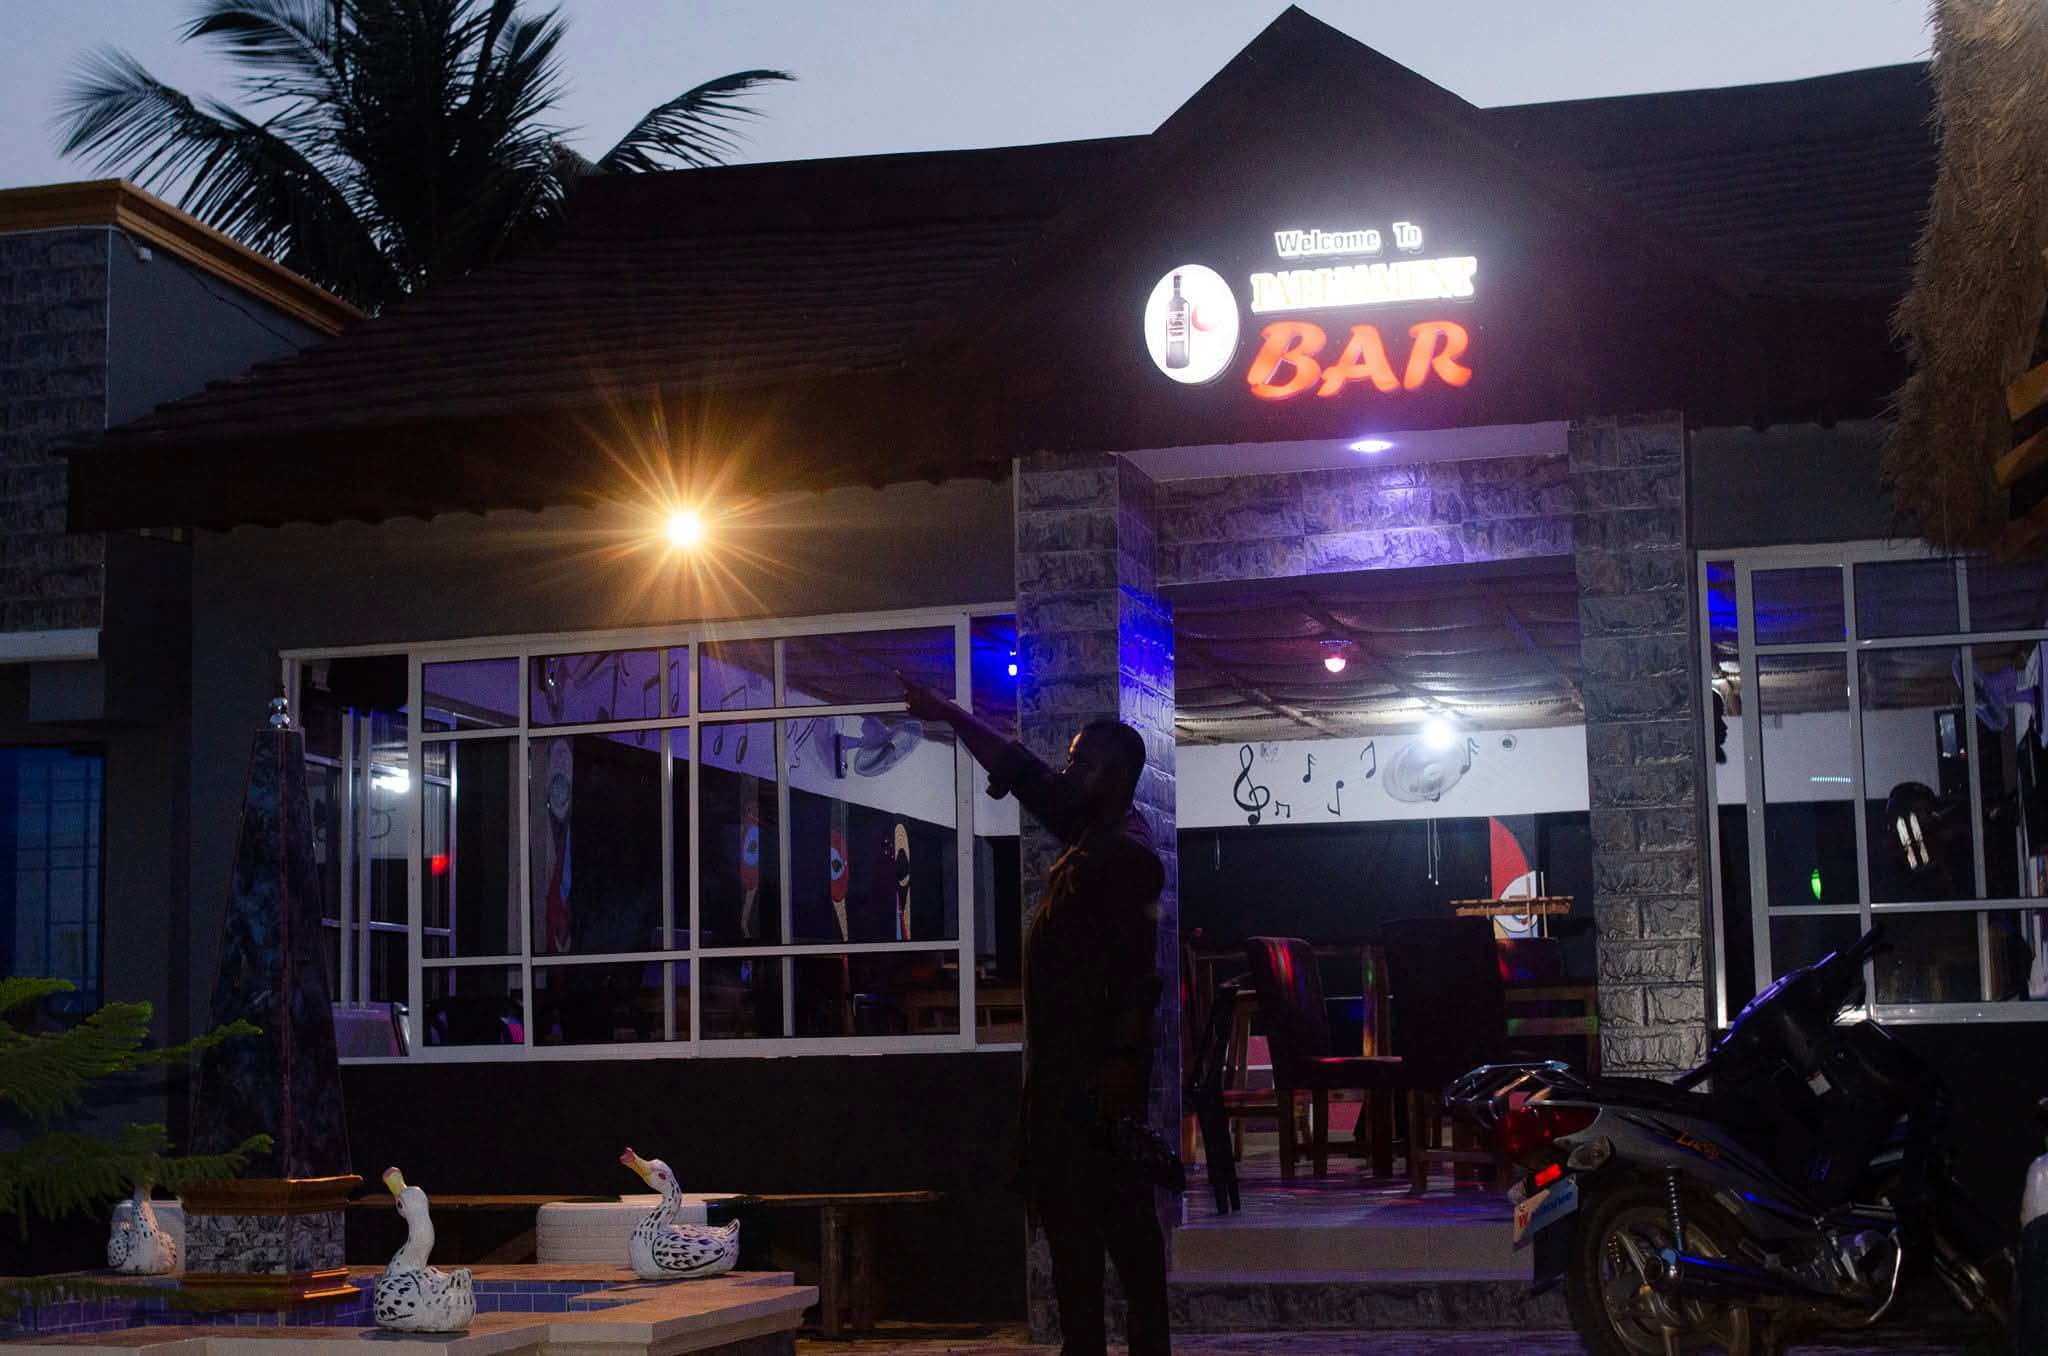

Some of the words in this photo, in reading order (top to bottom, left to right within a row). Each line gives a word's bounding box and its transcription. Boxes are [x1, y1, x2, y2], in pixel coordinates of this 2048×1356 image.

[1275, 229, 1380, 255] Welcome
[1393, 222, 1421, 247] To
[1247, 321, 1473, 400] BAR
